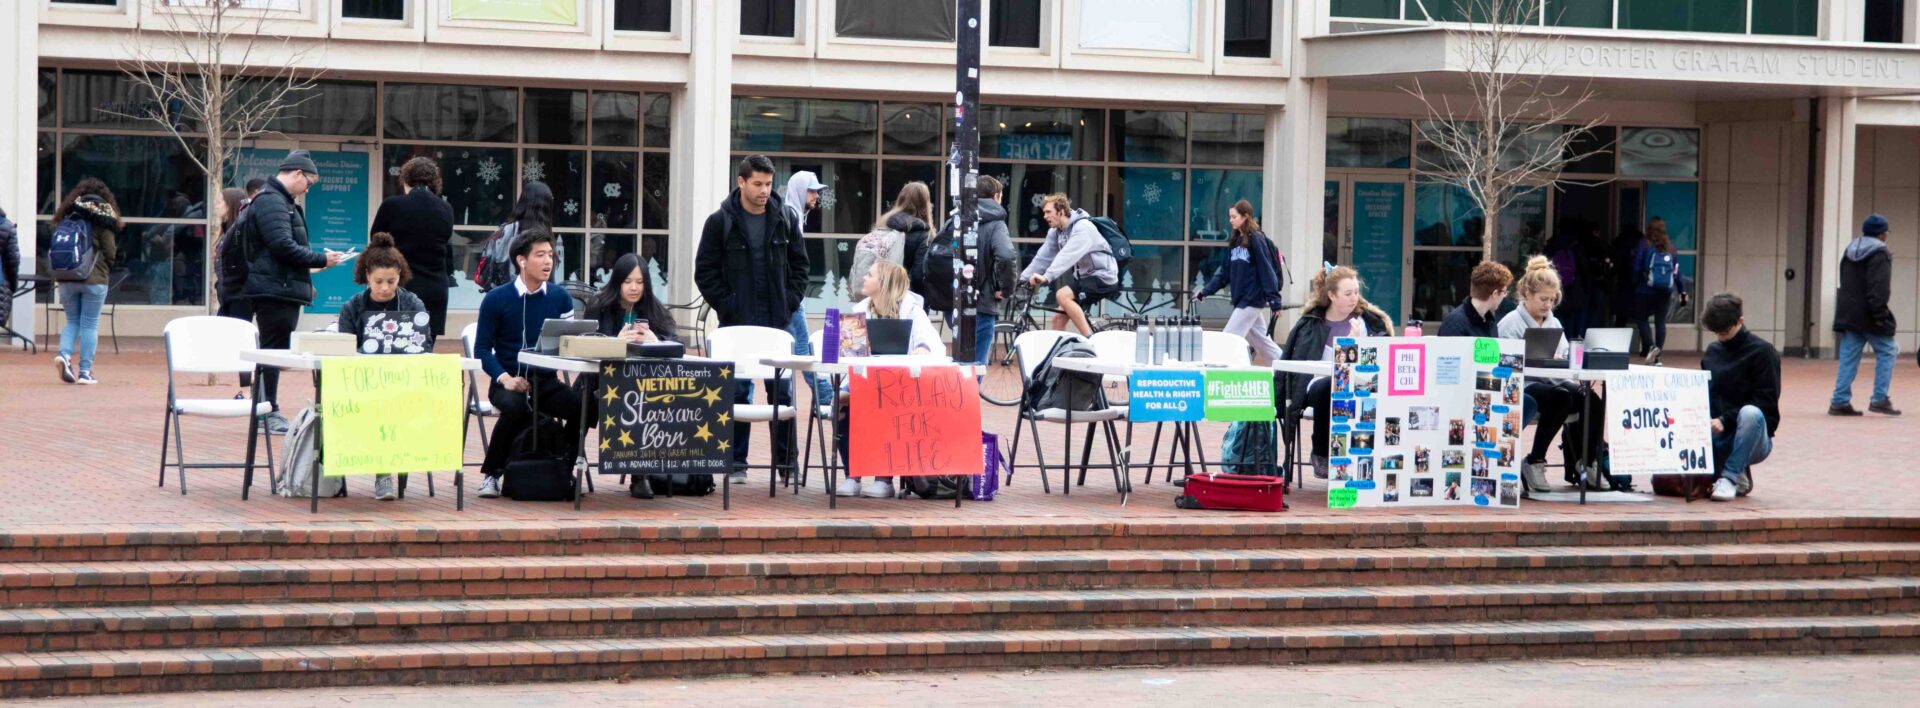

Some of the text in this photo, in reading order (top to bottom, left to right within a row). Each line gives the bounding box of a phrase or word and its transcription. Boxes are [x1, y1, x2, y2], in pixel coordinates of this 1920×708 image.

[1564, 44, 1657, 70] PORTER
[1672, 49, 1781, 75] GRAHAM
[1796, 53, 1905, 80] STUDENT
[319, 176, 344, 185] TUDENT
[321, 184, 352, 192] SUPPORT
[1474, 339, 1490, 350] Our
[1401, 353, 1414, 362] PHI
[1474, 350, 1498, 362] Events
[623, 364, 712, 378] UNC VSA Presents
[1397, 365, 1417, 374] BETA
[420, 368, 449, 391] the
[636, 377, 697, 392] VIETNITE
[1137, 379, 1196, 388] REPRODUCTIVE
[1400, 377, 1414, 386] CHI
[1611, 373, 1706, 392] COMPANY CAROLINA
[874, 368, 963, 412] RELAY
[1133, 390, 1201, 399] HEALTH & RIGHTS
[1208, 380, 1270, 399] #Fight4HER
[620, 390, 704, 426] Stars are
[1145, 401, 1178, 410] FOR ALL
[892, 410, 942, 441] FOR
[1622, 407, 1670, 430] agnes
[639, 423, 689, 450] Born
[1660, 431, 1674, 449] of
[334, 453, 384, 469] January
[612, 450, 639, 459] JANUARY
[667, 449, 688, 458] GREAT
[689, 448, 705, 457] HALL
[883, 438, 953, 473] LIFE
[1679, 446, 1707, 471] god
[629, 460, 659, 468] ADVANCE
[681, 460, 690, 468] AT
[693, 460, 706, 468] THE
[707, 460, 725, 468] DOOR
